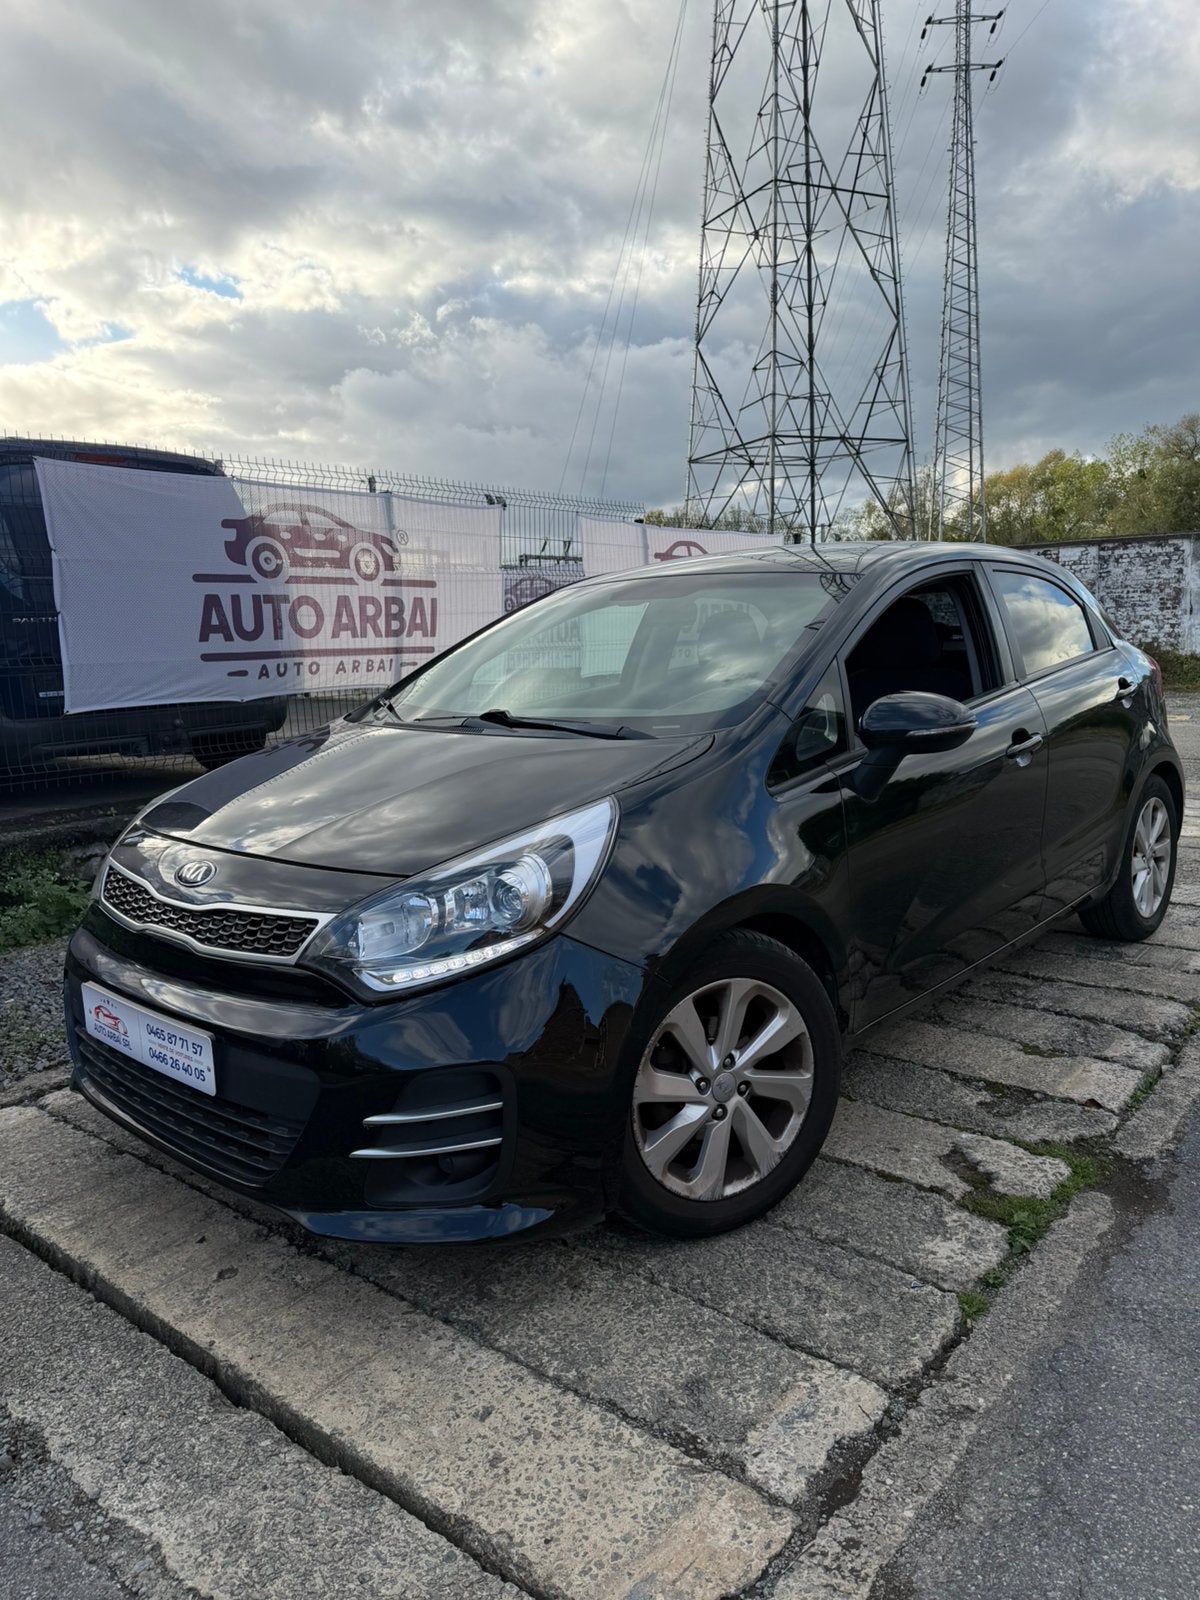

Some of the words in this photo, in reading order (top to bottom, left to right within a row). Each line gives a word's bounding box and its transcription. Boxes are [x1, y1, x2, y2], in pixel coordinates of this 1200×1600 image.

[199, 593, 325, 643] AUTO
[331, 595, 438, 640] ARBAI
[258, 661, 320, 680] AUTO
[335, 658, 394, 675] ARBAI
[146, 1023, 166, 1042] 0465
[167, 1032, 177, 1047] 87
[179, 1037, 189, 1052] 71
[191, 1042, 203, 1057] 57
[149, 1046, 168, 1066] 0466
[170, 1056, 181, 1071] 26
[181, 1062, 193, 1077] 40
[194, 1067, 206, 1082] 05
